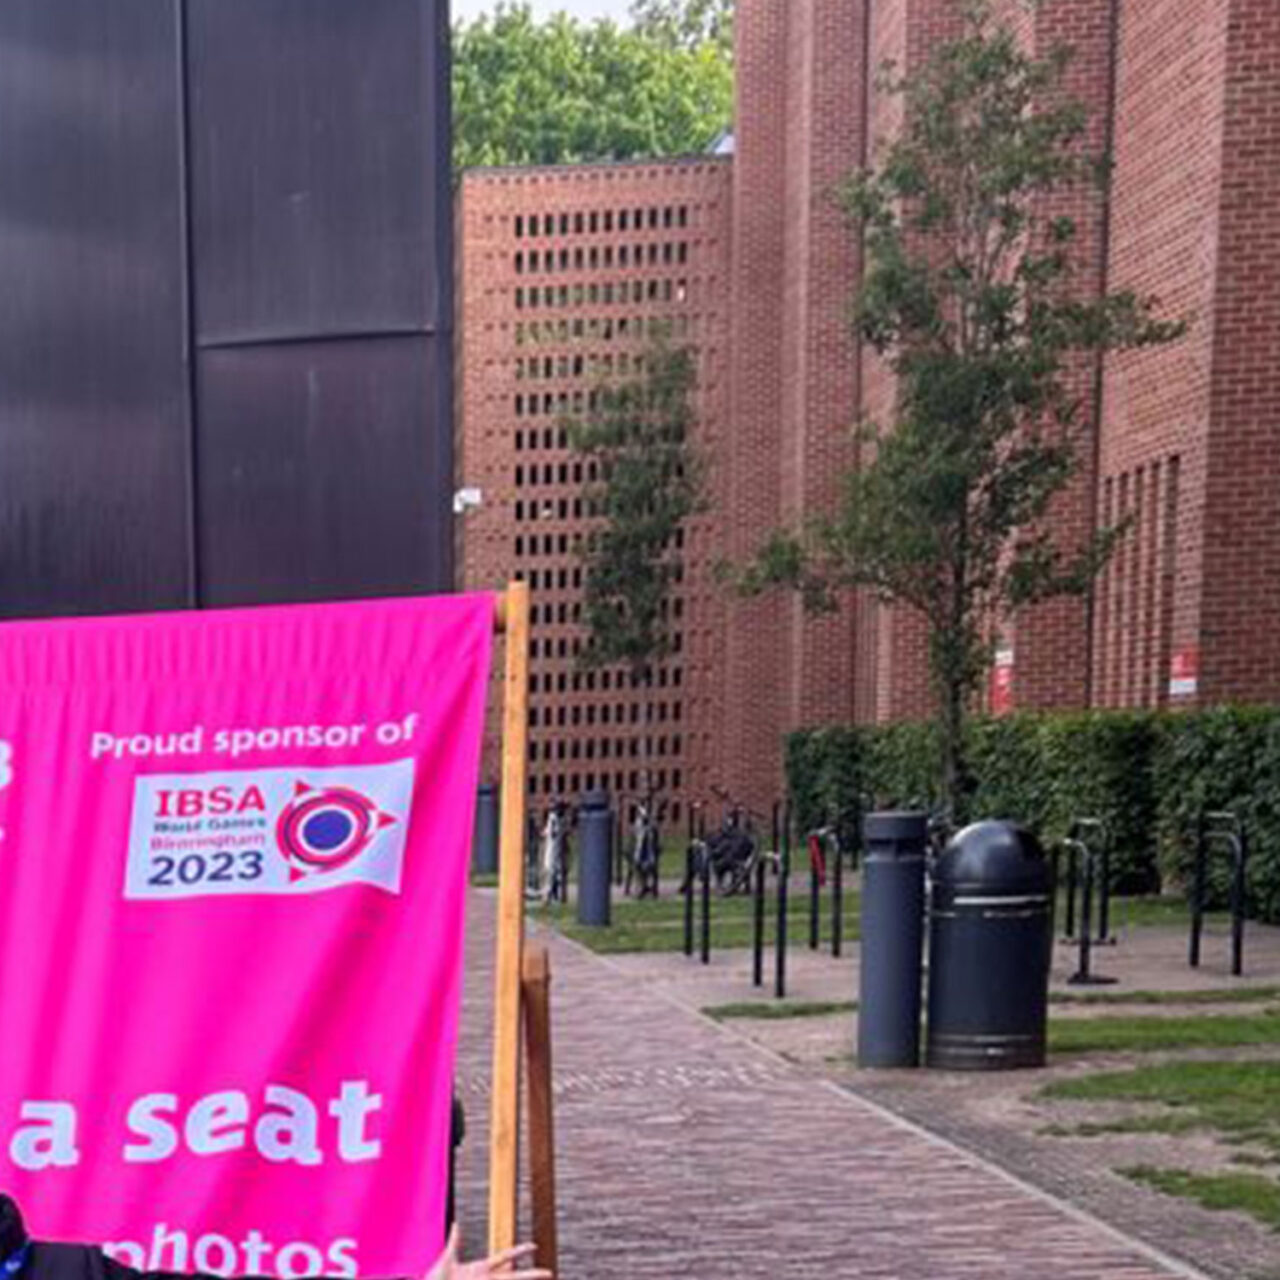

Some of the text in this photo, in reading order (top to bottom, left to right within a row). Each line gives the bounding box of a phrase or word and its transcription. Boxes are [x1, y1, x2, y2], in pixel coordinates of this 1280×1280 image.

[91, 713, 417, 759] Proud sponsor of
[154, 784, 266, 818] IBSA
[147, 850, 264, 886] 2023
[9, 1101, 80, 1171] a
[122, 1081, 383, 1166] seat
